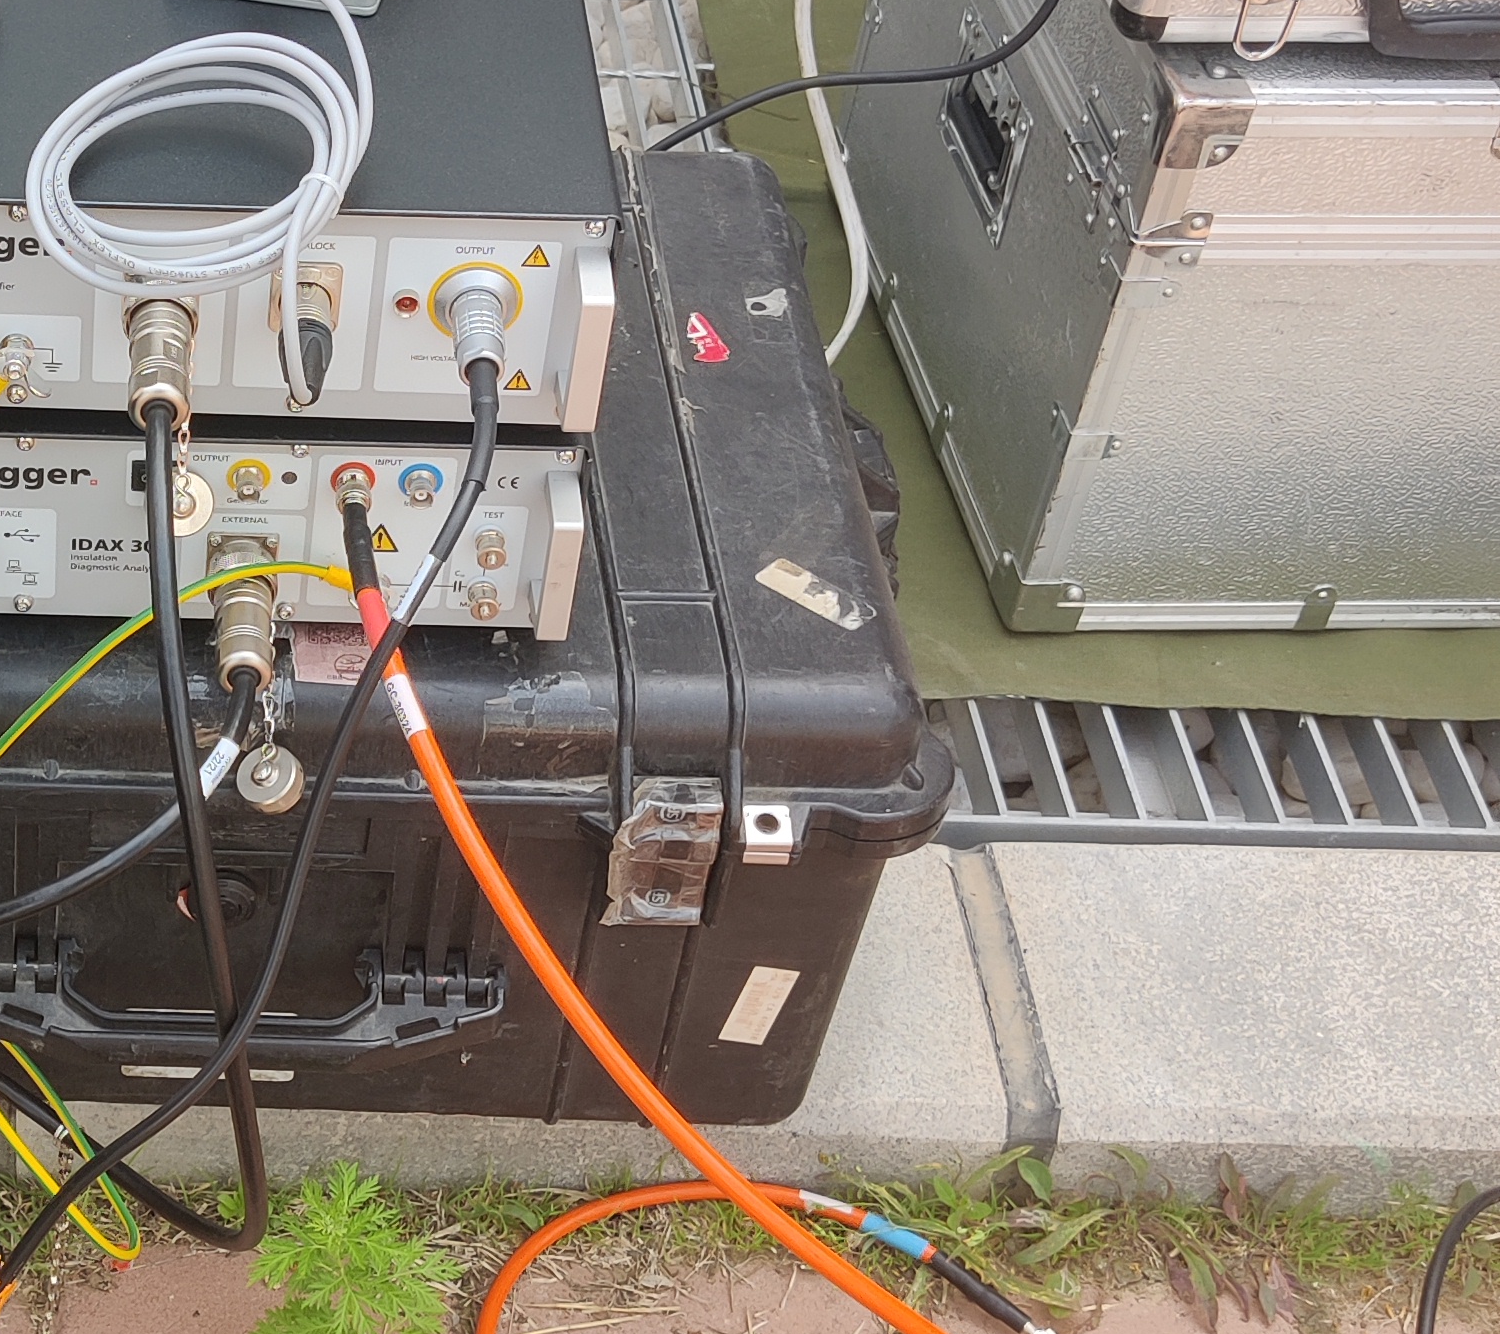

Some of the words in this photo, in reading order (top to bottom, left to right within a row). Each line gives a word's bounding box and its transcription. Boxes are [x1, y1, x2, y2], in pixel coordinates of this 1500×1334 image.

[455, 246, 496, 255] OUTPUT
[193, 454, 231, 462] OUTPUT
[498, 476, 520, 489] CE
[483, 511, 505, 519] TEST
[222, 516, 268, 524] EXTERNAL
[71, 539, 124, 552] IDAX
[71, 563, 120, 572] Diagnostic
